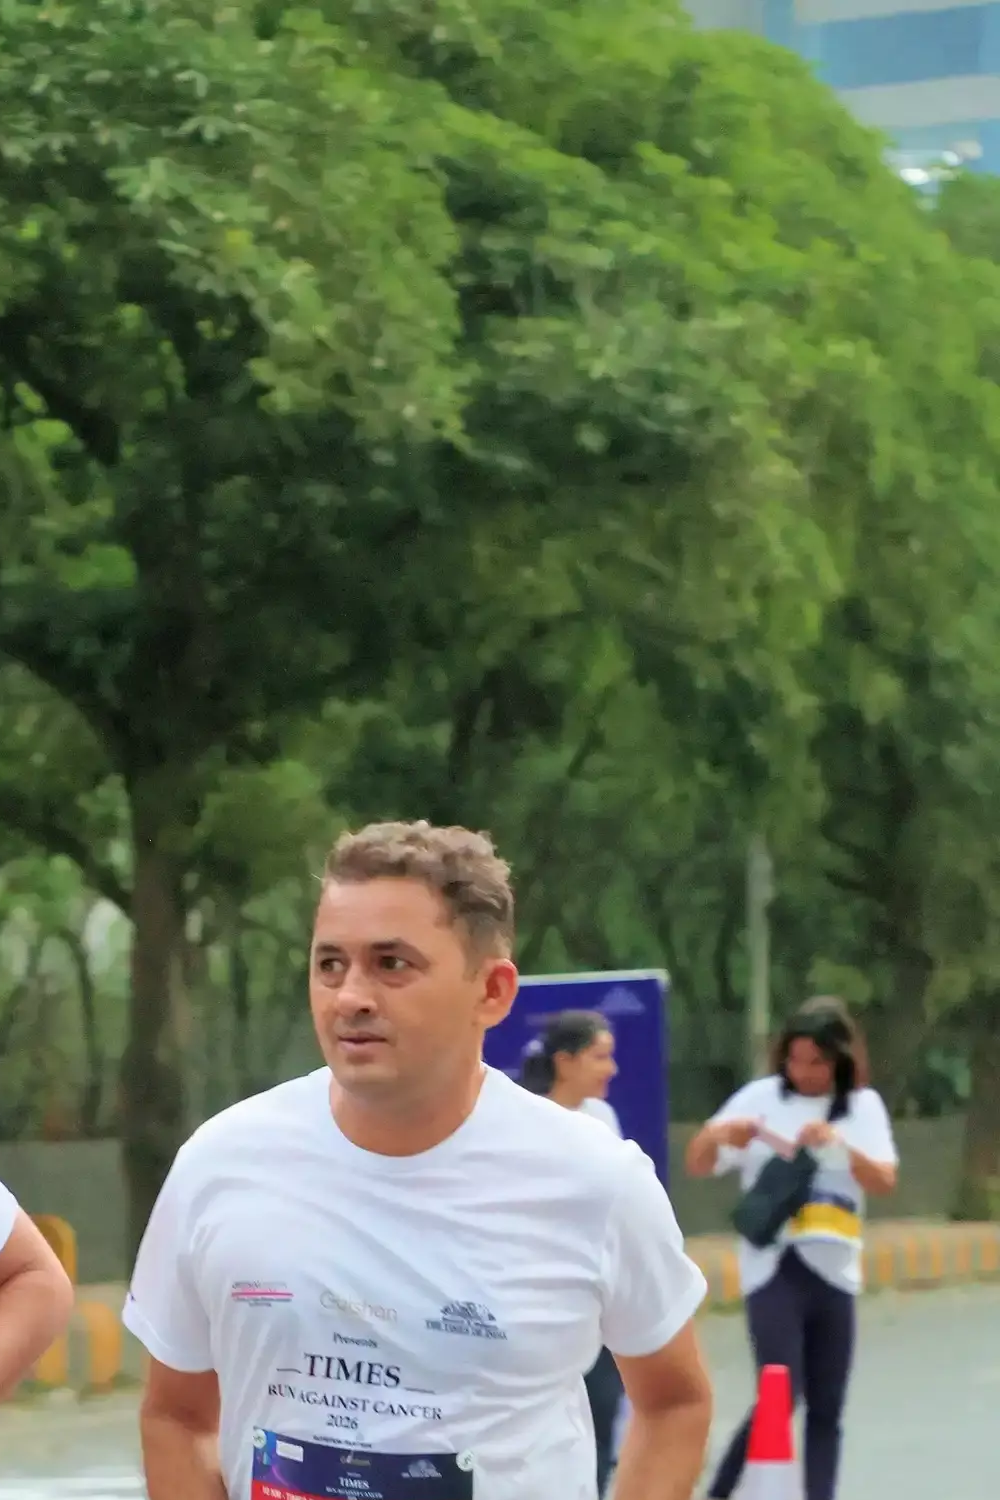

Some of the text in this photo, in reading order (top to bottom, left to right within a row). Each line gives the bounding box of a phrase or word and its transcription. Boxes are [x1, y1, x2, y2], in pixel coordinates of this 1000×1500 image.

[319, 1289, 397, 1325] Gulshan
[333, 1331, 378, 1348] Presents
[304, 1352, 401, 1388] TIMES
[268, 1383, 442, 1421] RUN AGAINST CANCER
[326, 1413, 359, 1430] 2026
[338, 1476, 370, 1490] TIMES
